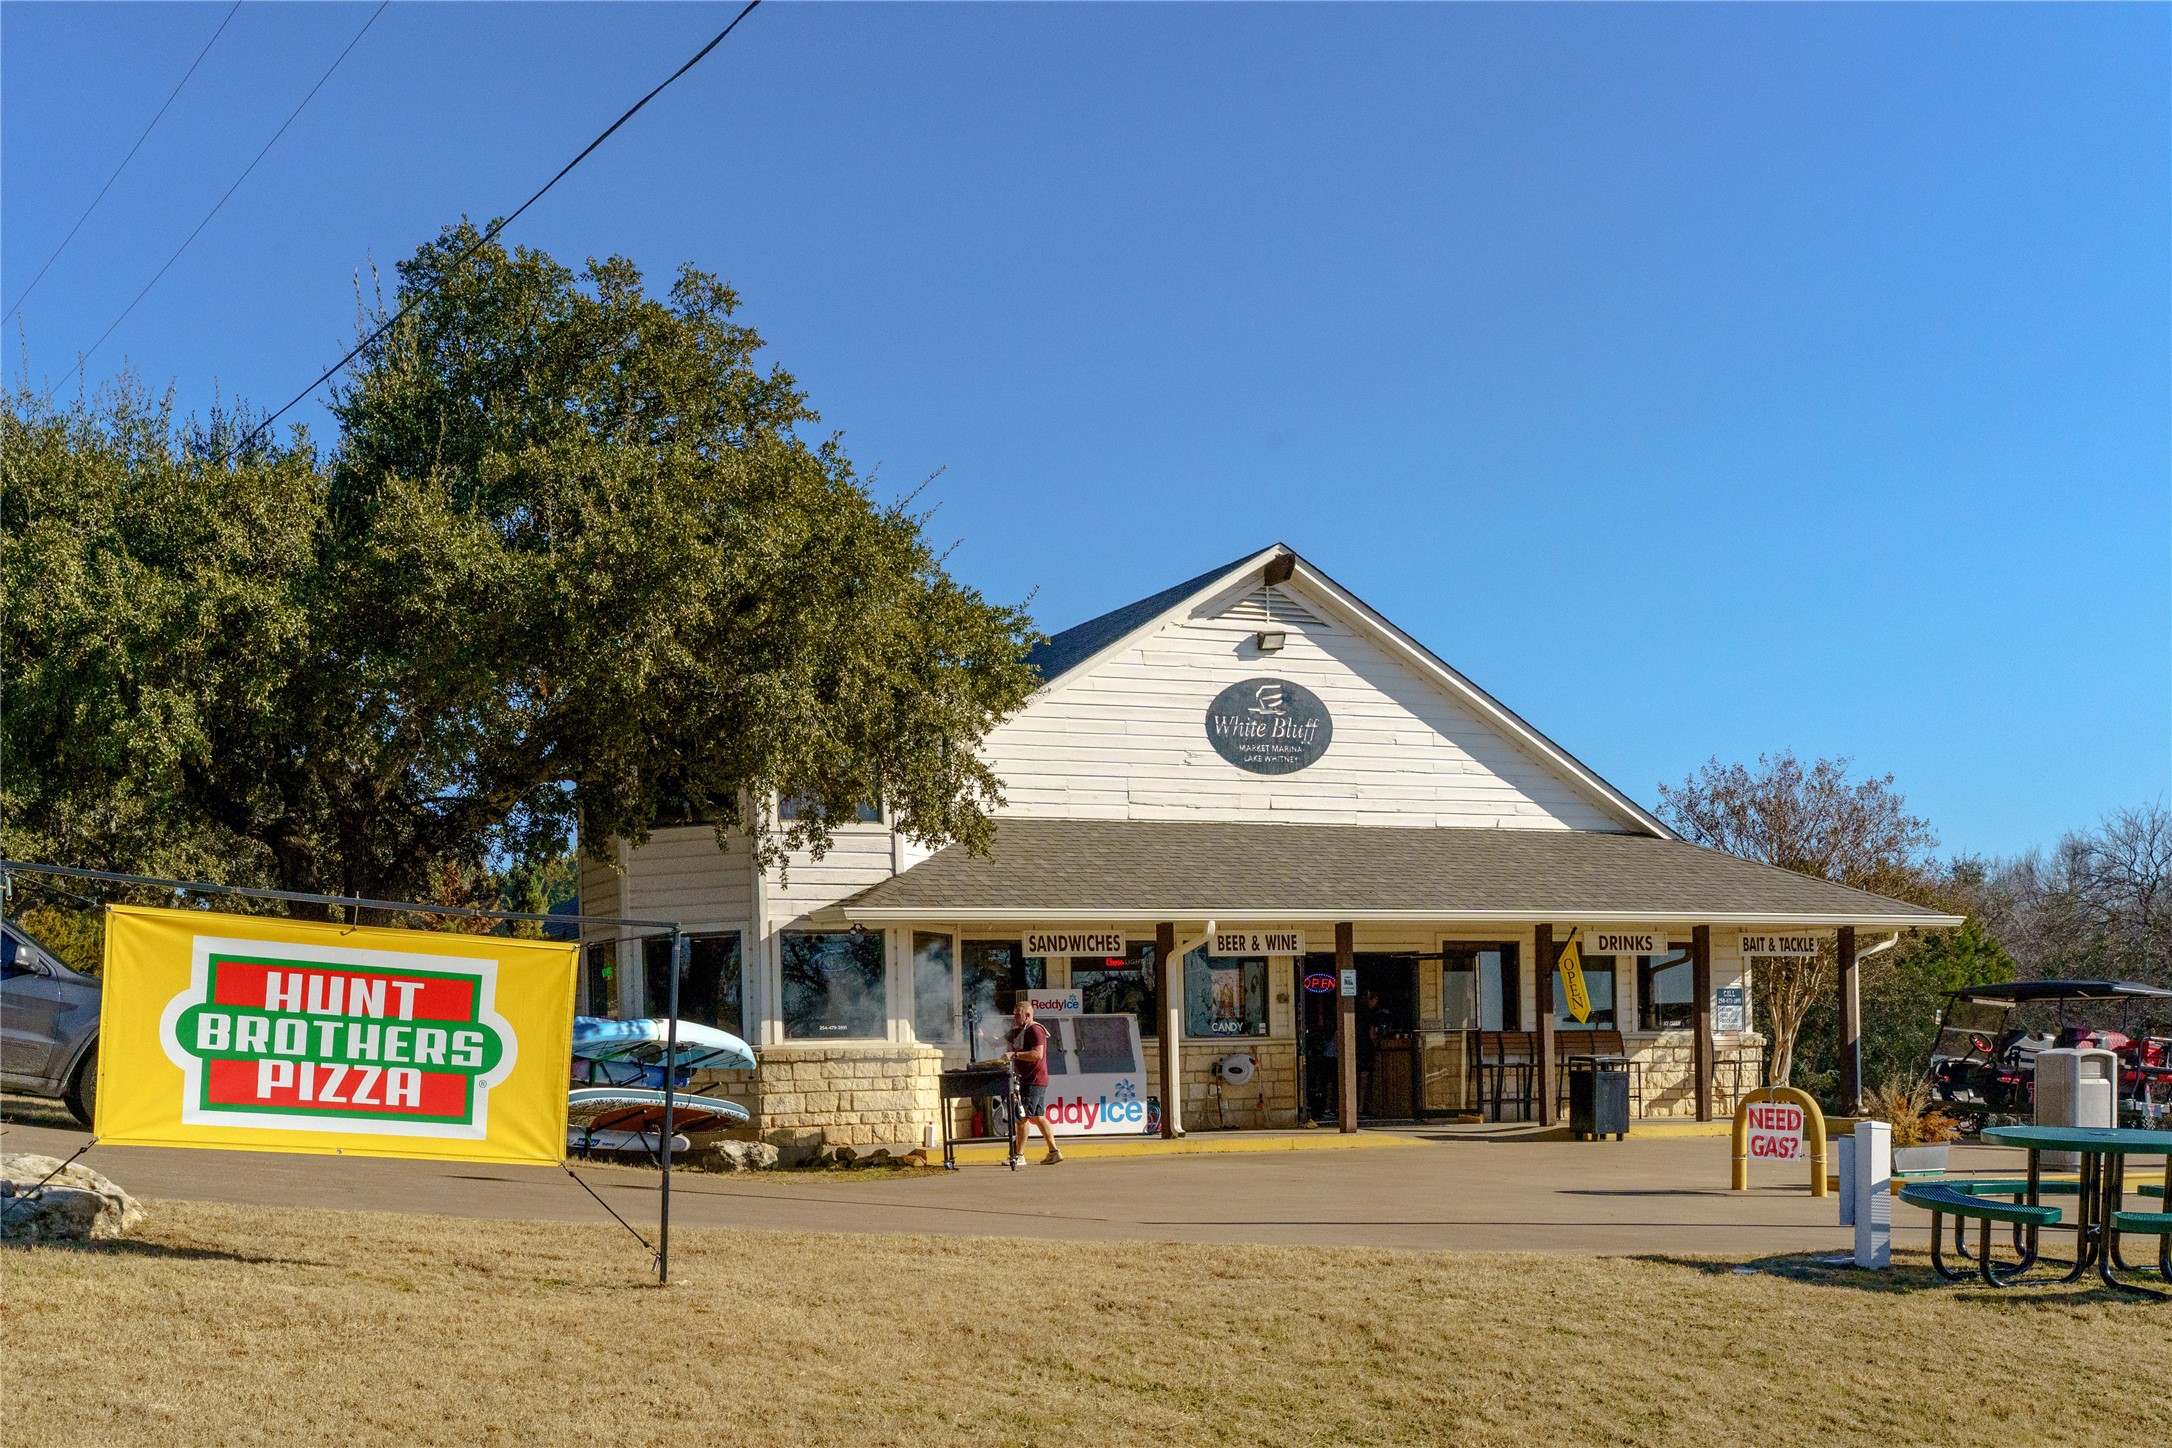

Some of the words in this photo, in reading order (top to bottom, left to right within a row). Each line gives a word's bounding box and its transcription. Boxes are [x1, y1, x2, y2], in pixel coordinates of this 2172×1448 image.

[1214, 715, 1267, 738] White
[1271, 717, 1320, 742] Bluff
[1238, 744, 1270, 753] MARKET
[1271, 744, 1303, 753] MARINA
[1243, 755, 1262, 763] LAKE
[1264, 755, 1299, 763] WHITNEY
[1028, 934, 1121, 952] SANDWICHES
[1217, 934, 1246, 951] BEER
[1251, 935, 1260, 951] &
[1265, 934, 1298, 951] WINE
[1598, 935, 1653, 951] DRINKS
[1743, 936, 1765, 952] BAIT
[1768, 936, 1776, 952] &
[1778, 936, 1814, 952] TACKLE
[1303, 977, 1337, 989] OPEN
[1563, 958, 1584, 1010] OPEN
[264, 971, 425, 1021] HUNT
[1031, 998, 1079, 1012] ReddyIce
[1211, 1022, 1244, 1032] CANDY
[196, 1012, 484, 1068] BROTHERS
[256, 1058, 422, 1108] PIZZA
[1028, 1096, 1143, 1130] ddyIce
[1748, 1107, 1802, 1131] NEED
[1750, 1135, 1799, 1159] GAS?
